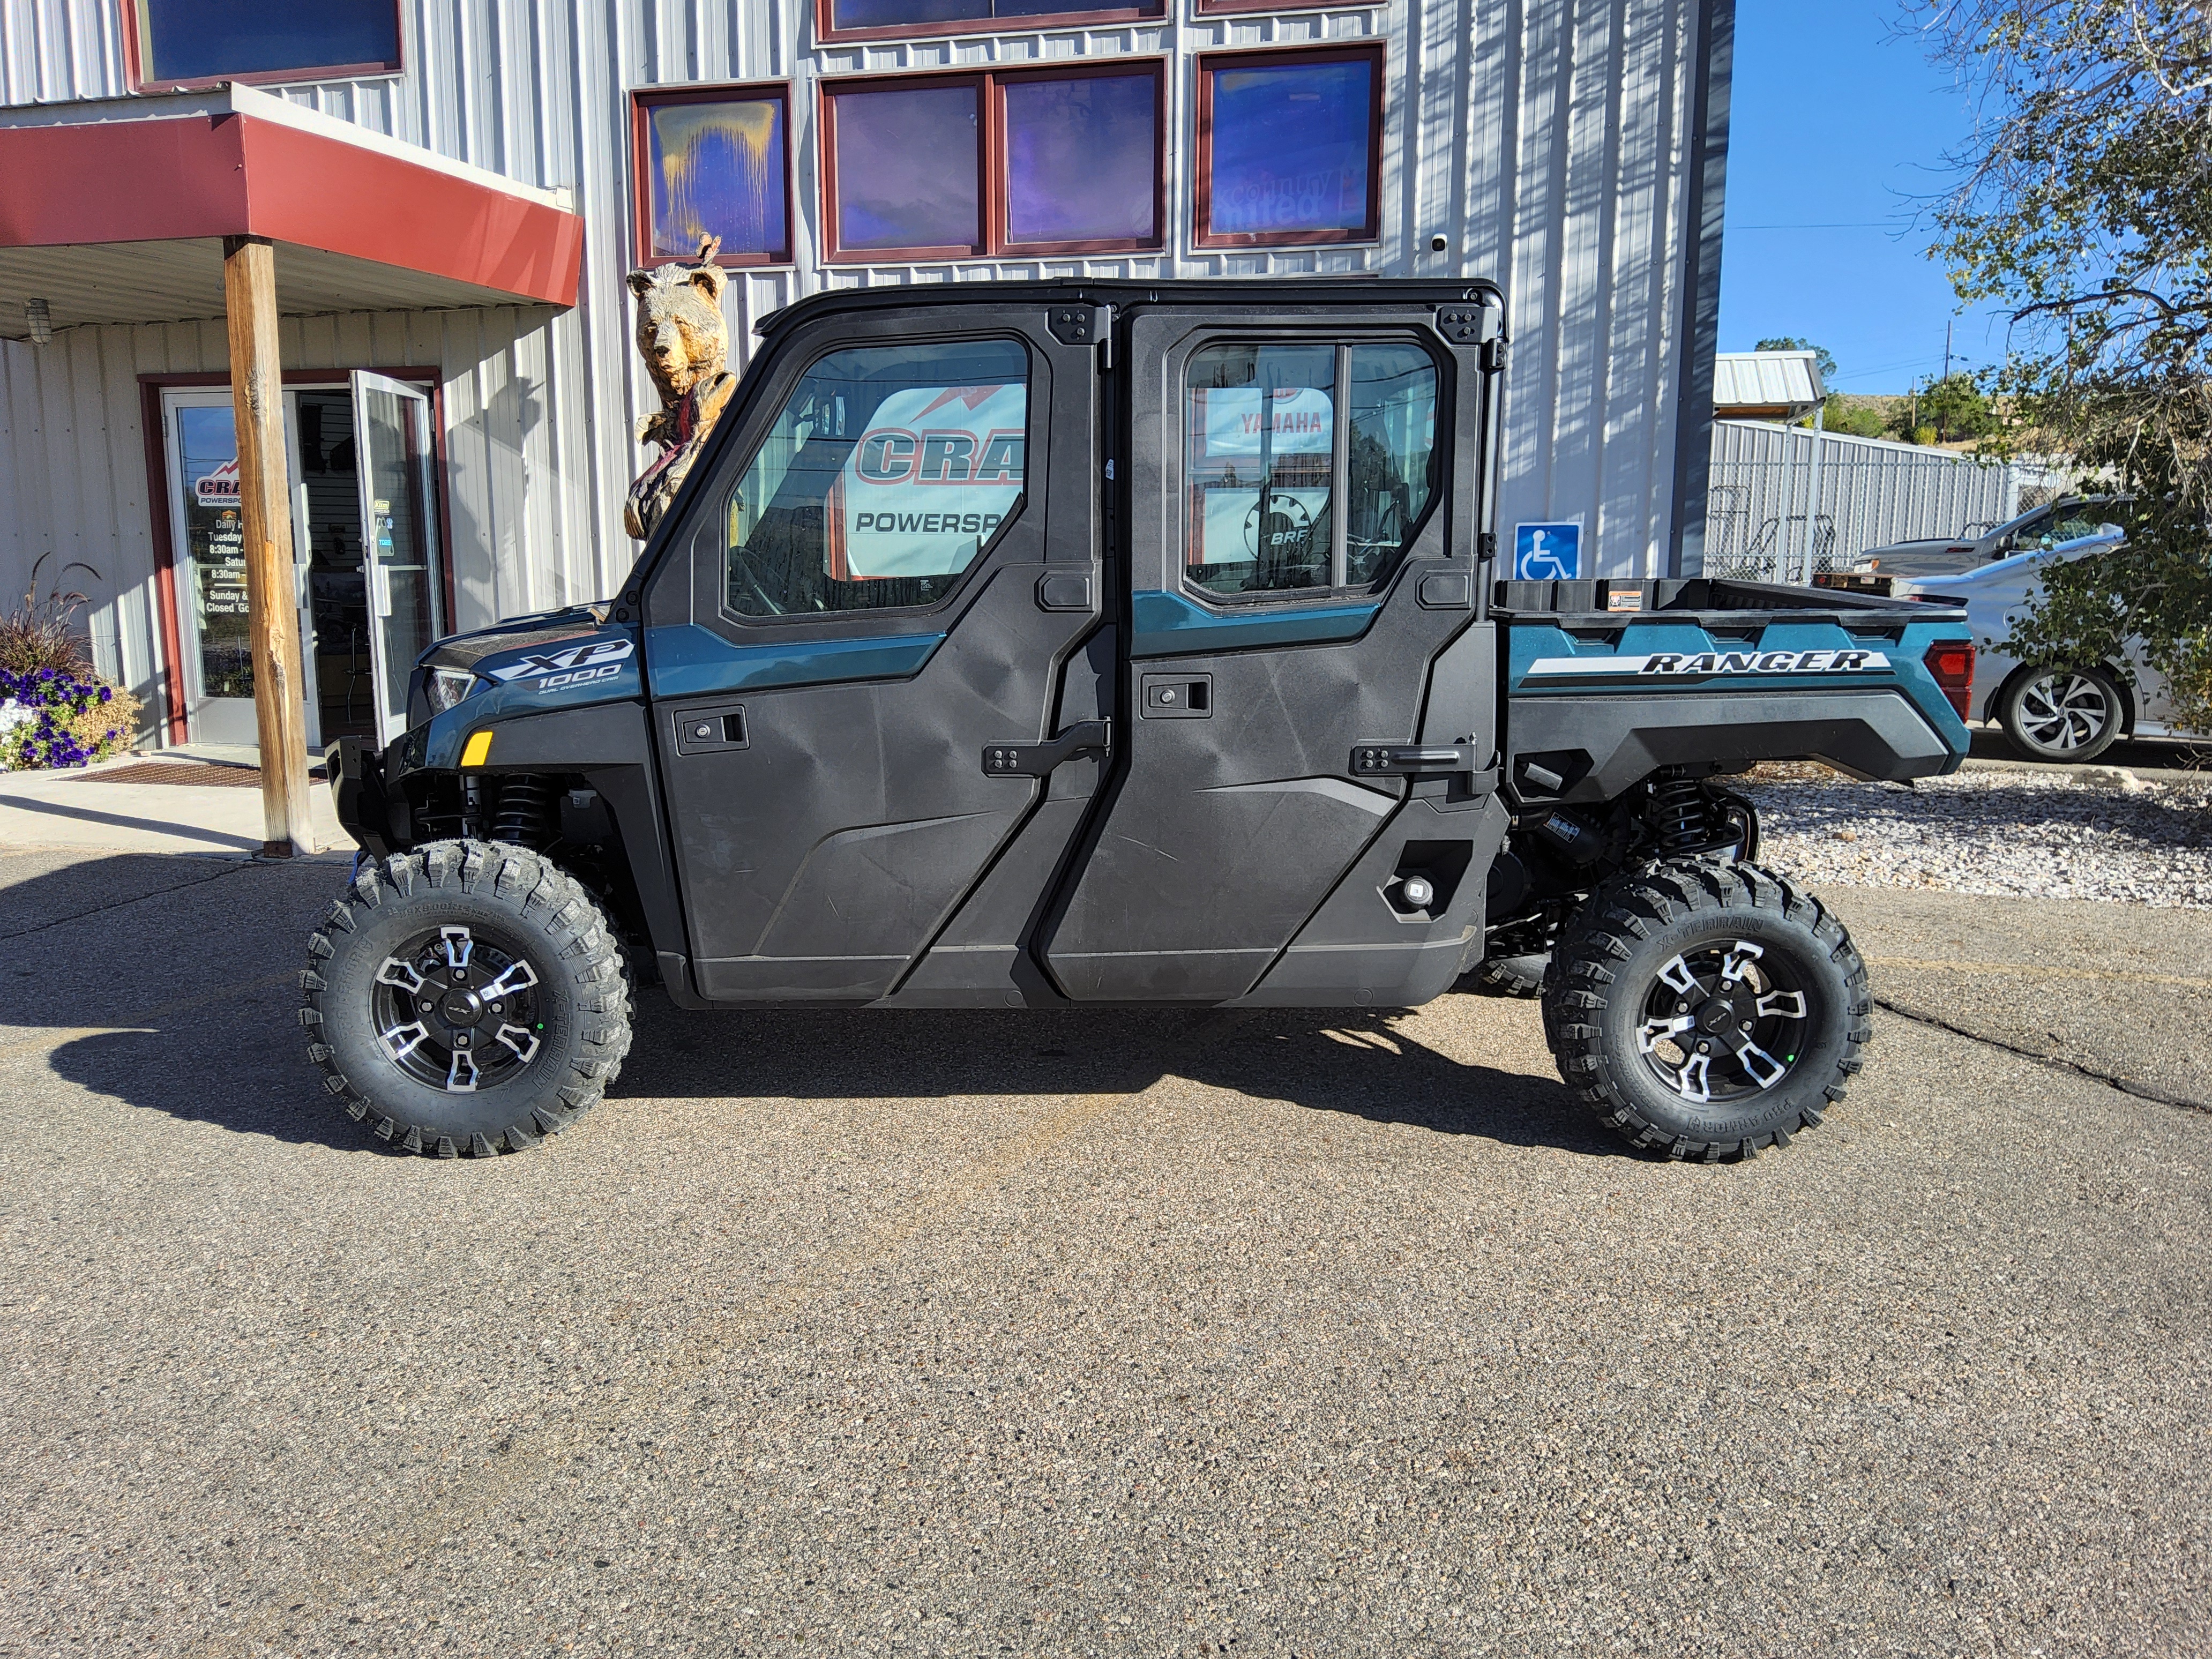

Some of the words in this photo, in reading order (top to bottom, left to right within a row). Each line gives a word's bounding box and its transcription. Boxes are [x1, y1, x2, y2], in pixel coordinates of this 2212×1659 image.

[1241, 412, 1321, 434] YAMAHA
[216, 520, 235, 531] Daily
[208, 532, 242, 543] Tuesday
[210, 544, 238, 554] 8:30am
[212, 570, 240, 579] 8:30am
[210, 590, 240, 602] Sunday
[206, 602, 234, 612] Closed
[508, 640, 631, 678] XP
[1639, 650, 1873, 675] RANGER
[539, 664, 622, 689] 1000
[560, 680, 601, 691] OVERHEAD
[1656, 914, 1763, 952] X-TERRAIN
[532, 989, 570, 1090] X-TERRAIN
